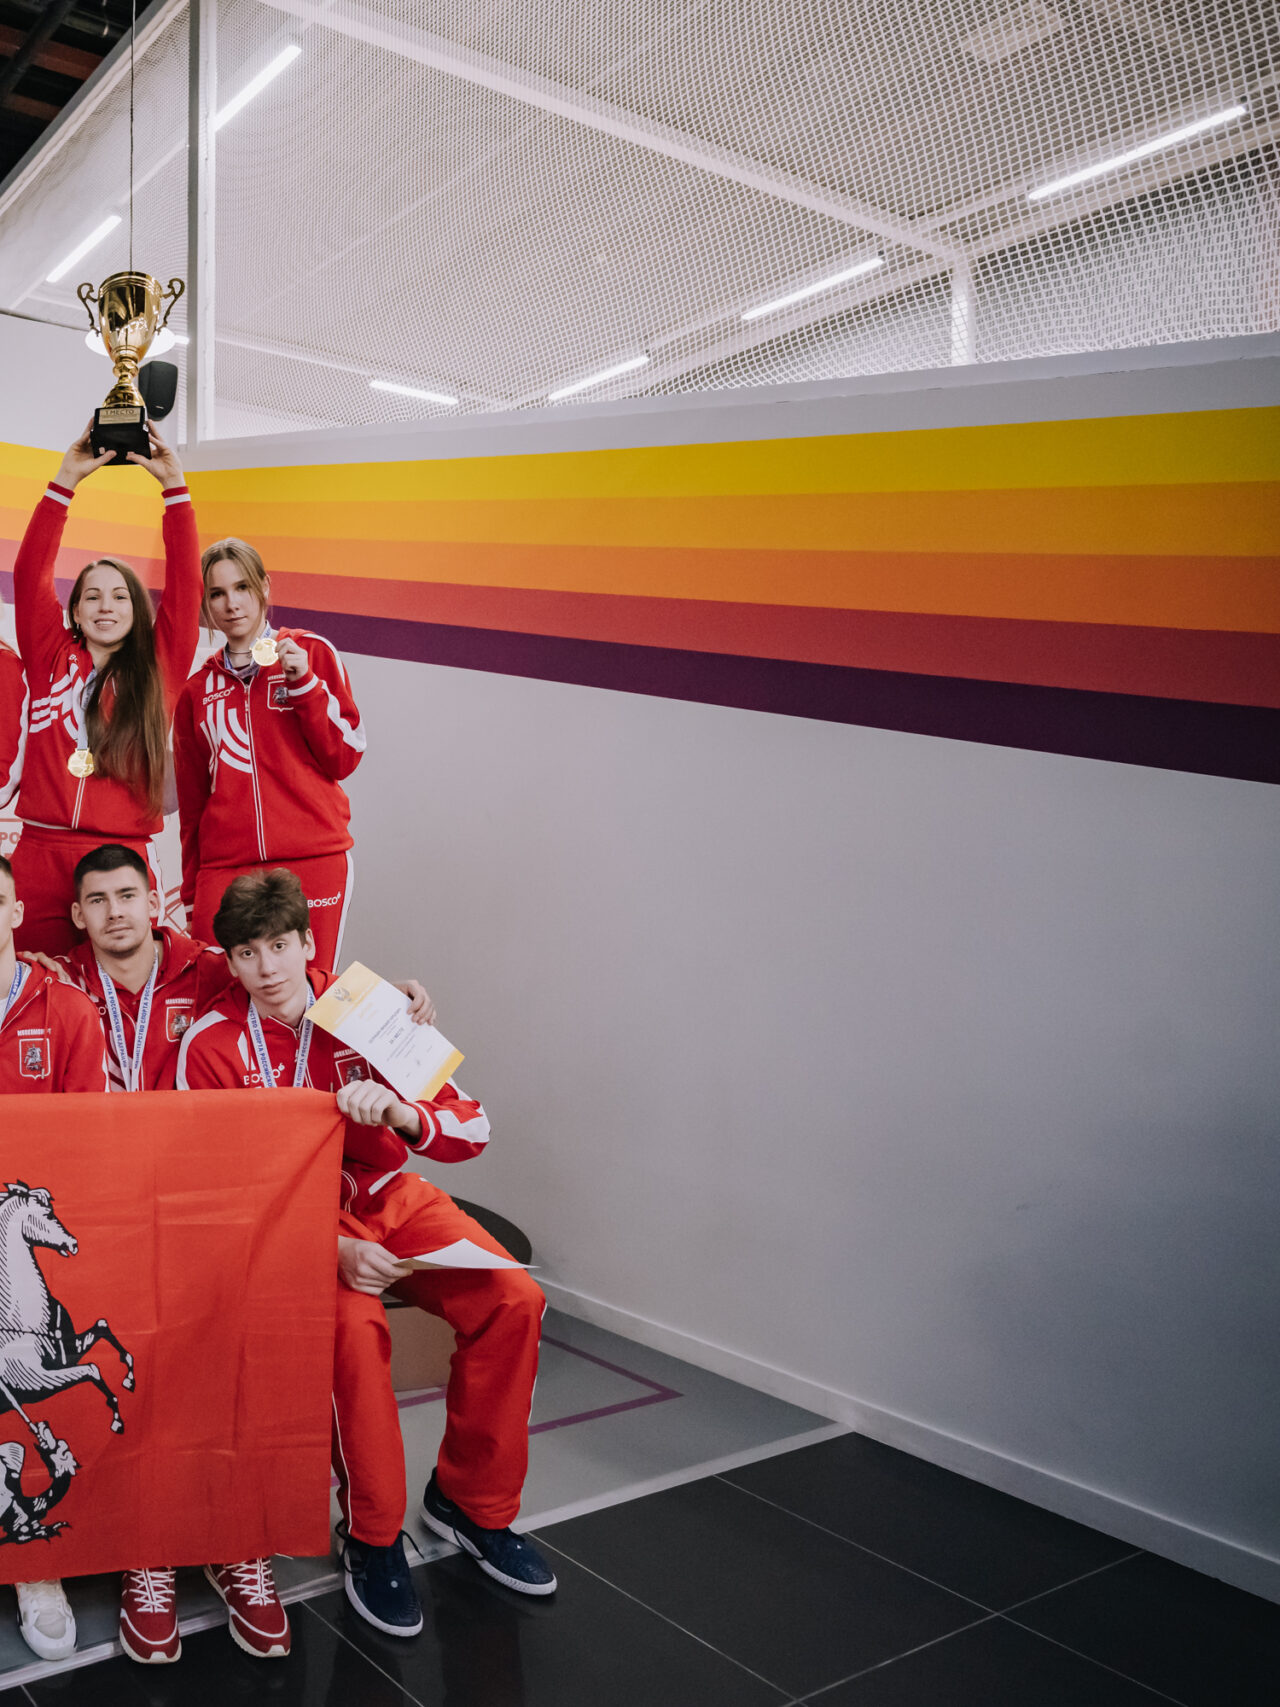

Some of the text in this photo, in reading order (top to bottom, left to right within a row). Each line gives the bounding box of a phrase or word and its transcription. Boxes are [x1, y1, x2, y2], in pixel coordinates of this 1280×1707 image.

[202, 690, 232, 706] BOSCO
[307, 896, 338, 908] BOSCO
[260, 1051, 272, 1087] РОССИЙСКО
